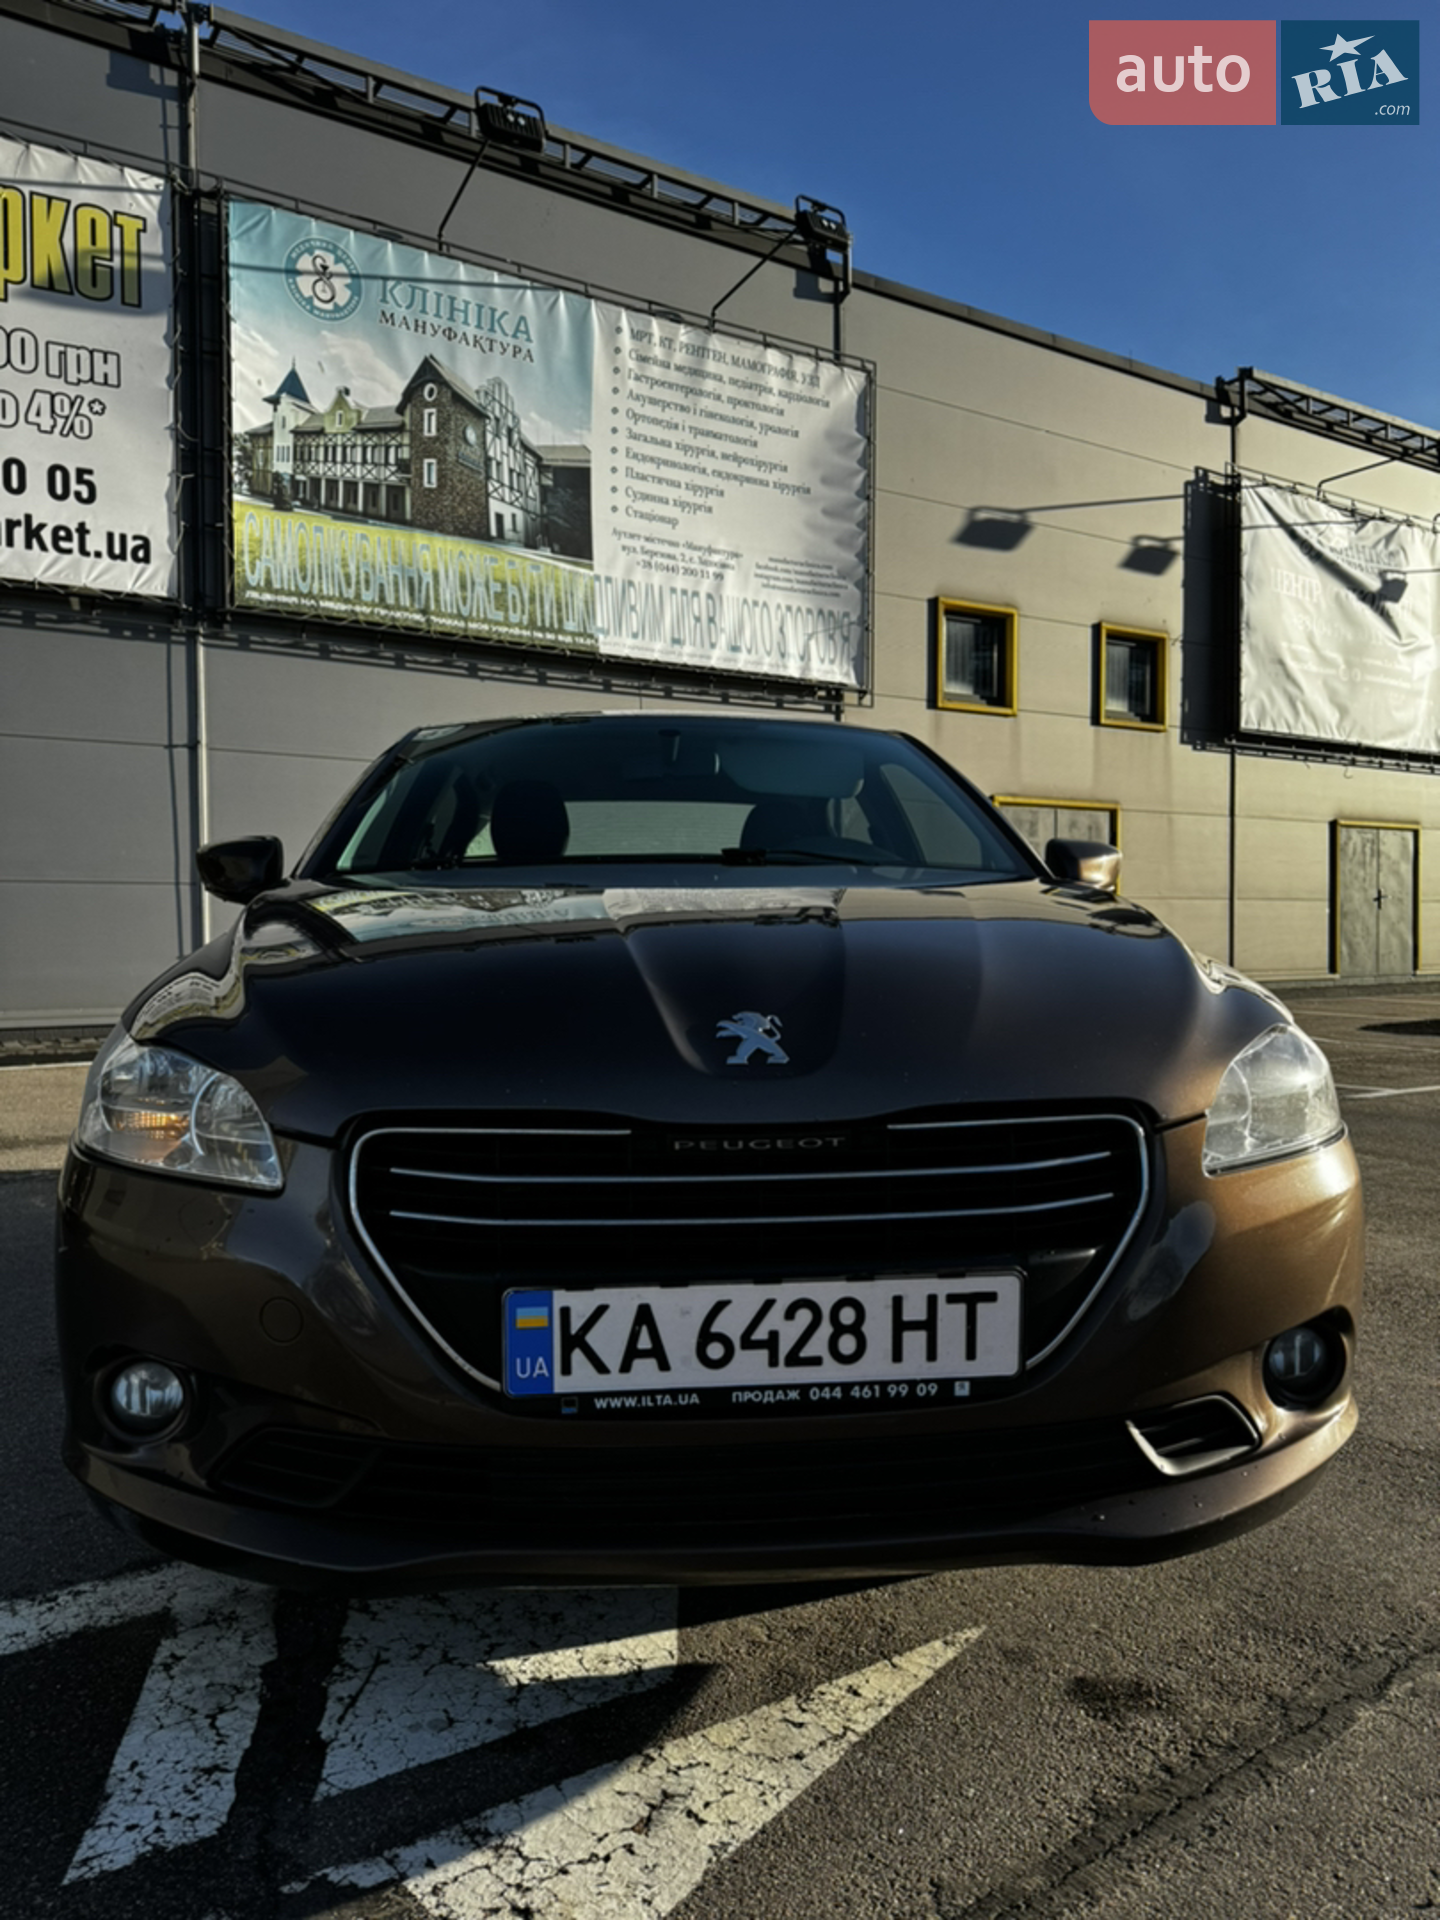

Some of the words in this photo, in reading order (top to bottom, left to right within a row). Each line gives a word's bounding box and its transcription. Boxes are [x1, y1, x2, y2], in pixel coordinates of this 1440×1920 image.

[379, 276, 533, 343] КЛІНІКА
[379, 309, 535, 363] МАНУФАКТУРА
[46, 340, 121, 388] грн
[626, 427, 672, 449] Загальна
[47, 463, 97, 505] 05
[625, 466, 681, 489] Пластична
[684, 479, 724, 499] хірургія
[772, 477, 811, 496] хірургія
[625, 504, 679, 530] Стаціонар
[672, 495, 713, 515] хірургія
[0, 513, 151, 564] rket.ua
[244, 511, 435, 611] САМОЛІКУВАННЯ
[437, 546, 504, 622] МОЖЕ
[505, 557, 559, 630] БУТИ
[561, 568, 667, 644] ШКІДЛИВИМ
[669, 586, 705, 649] ДЛЯ
[706, 591, 773, 657] ВАШОГО
[674, 1137, 846, 1151] PEUGEOT
[559, 1302, 672, 1376] KA
[696, 1297, 868, 1370] 6428
[892, 1291, 998, 1363] HT
[516, 1356, 549, 1380] UA
[594, 1393, 700, 1410] WWW.ILTA.UA
[731, 1388, 801, 1404] ПРОДАЖ
[809, 1386, 843, 1401] 044
[850, 1384, 881, 1399] 461
[887, 1383, 910, 1398] 99
[916, 1382, 939, 1397] 09
